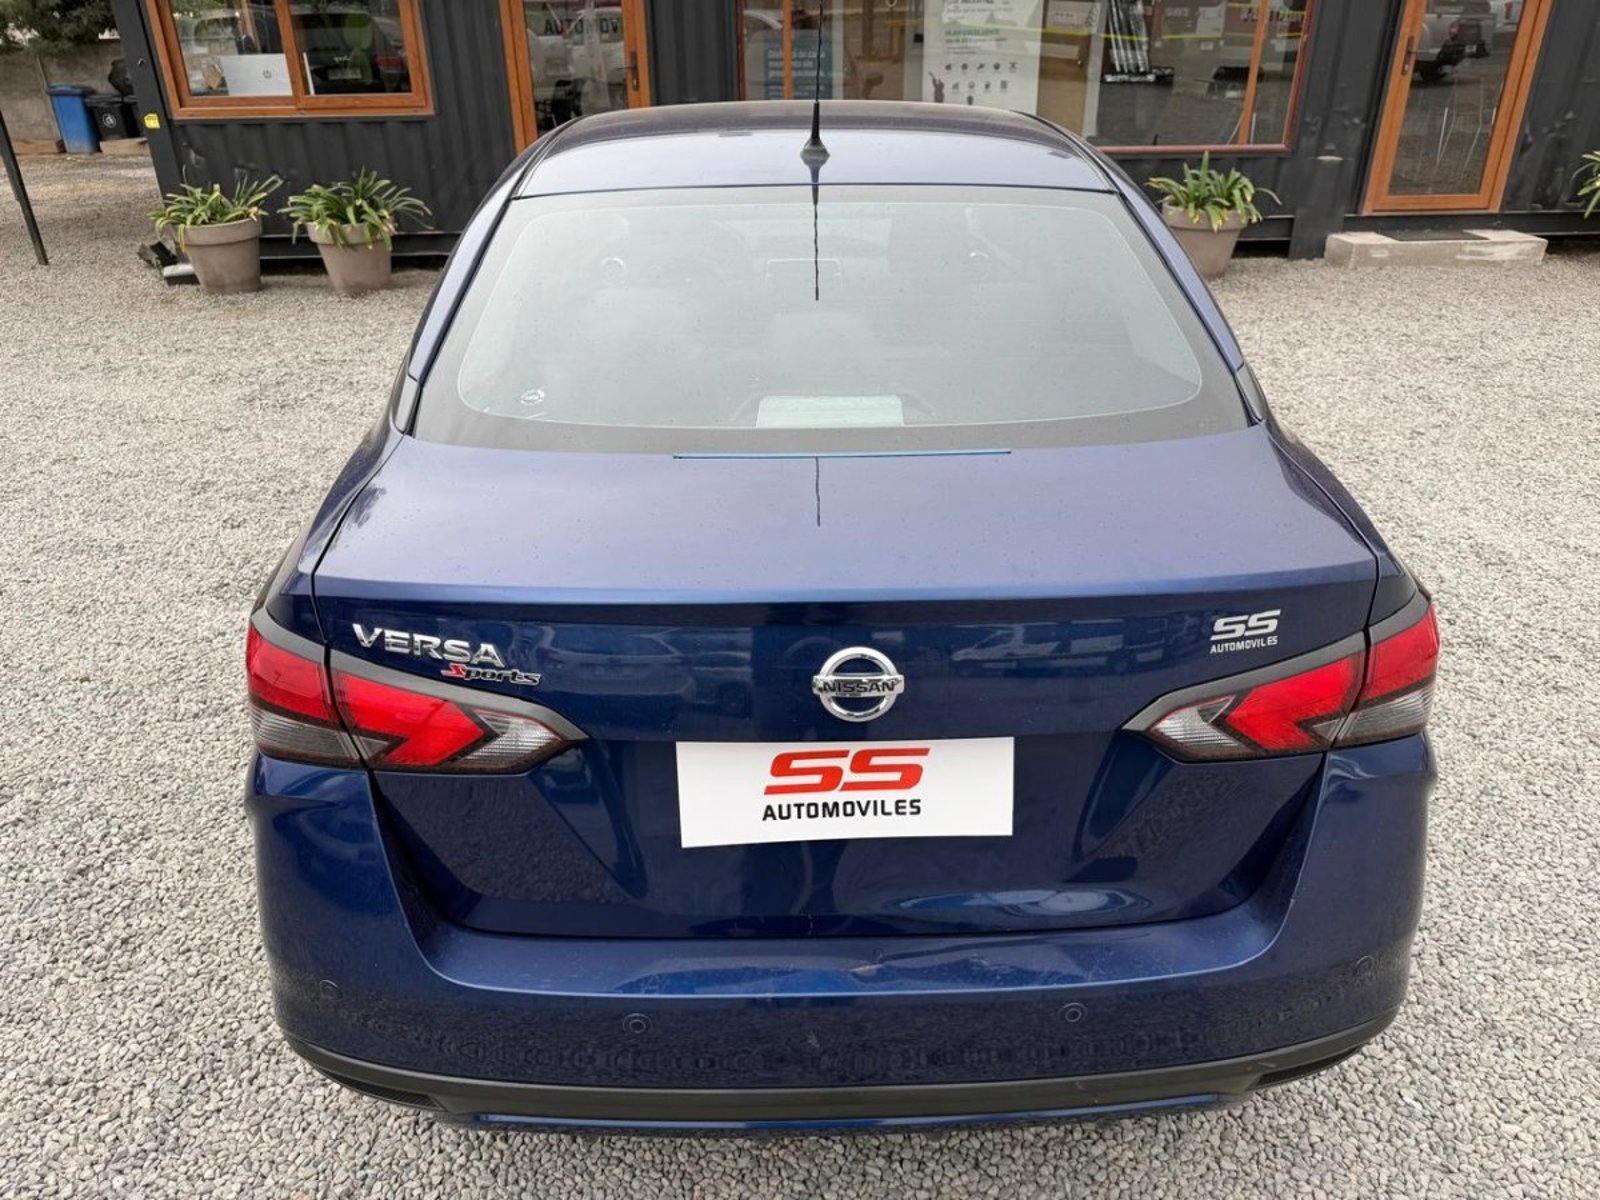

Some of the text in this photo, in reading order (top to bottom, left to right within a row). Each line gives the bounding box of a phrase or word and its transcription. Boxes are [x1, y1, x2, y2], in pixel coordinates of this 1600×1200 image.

[1210, 609, 1281, 640] SS
[352, 623, 505, 667] VERSA
[1210, 635, 1278, 654] AUTOMOVILES
[440, 662, 541, 686] Sports
[822, 680, 896, 693] NISSAN
[763, 747, 930, 795] SS
[762, 798, 922, 822] AUTOMOVILES
